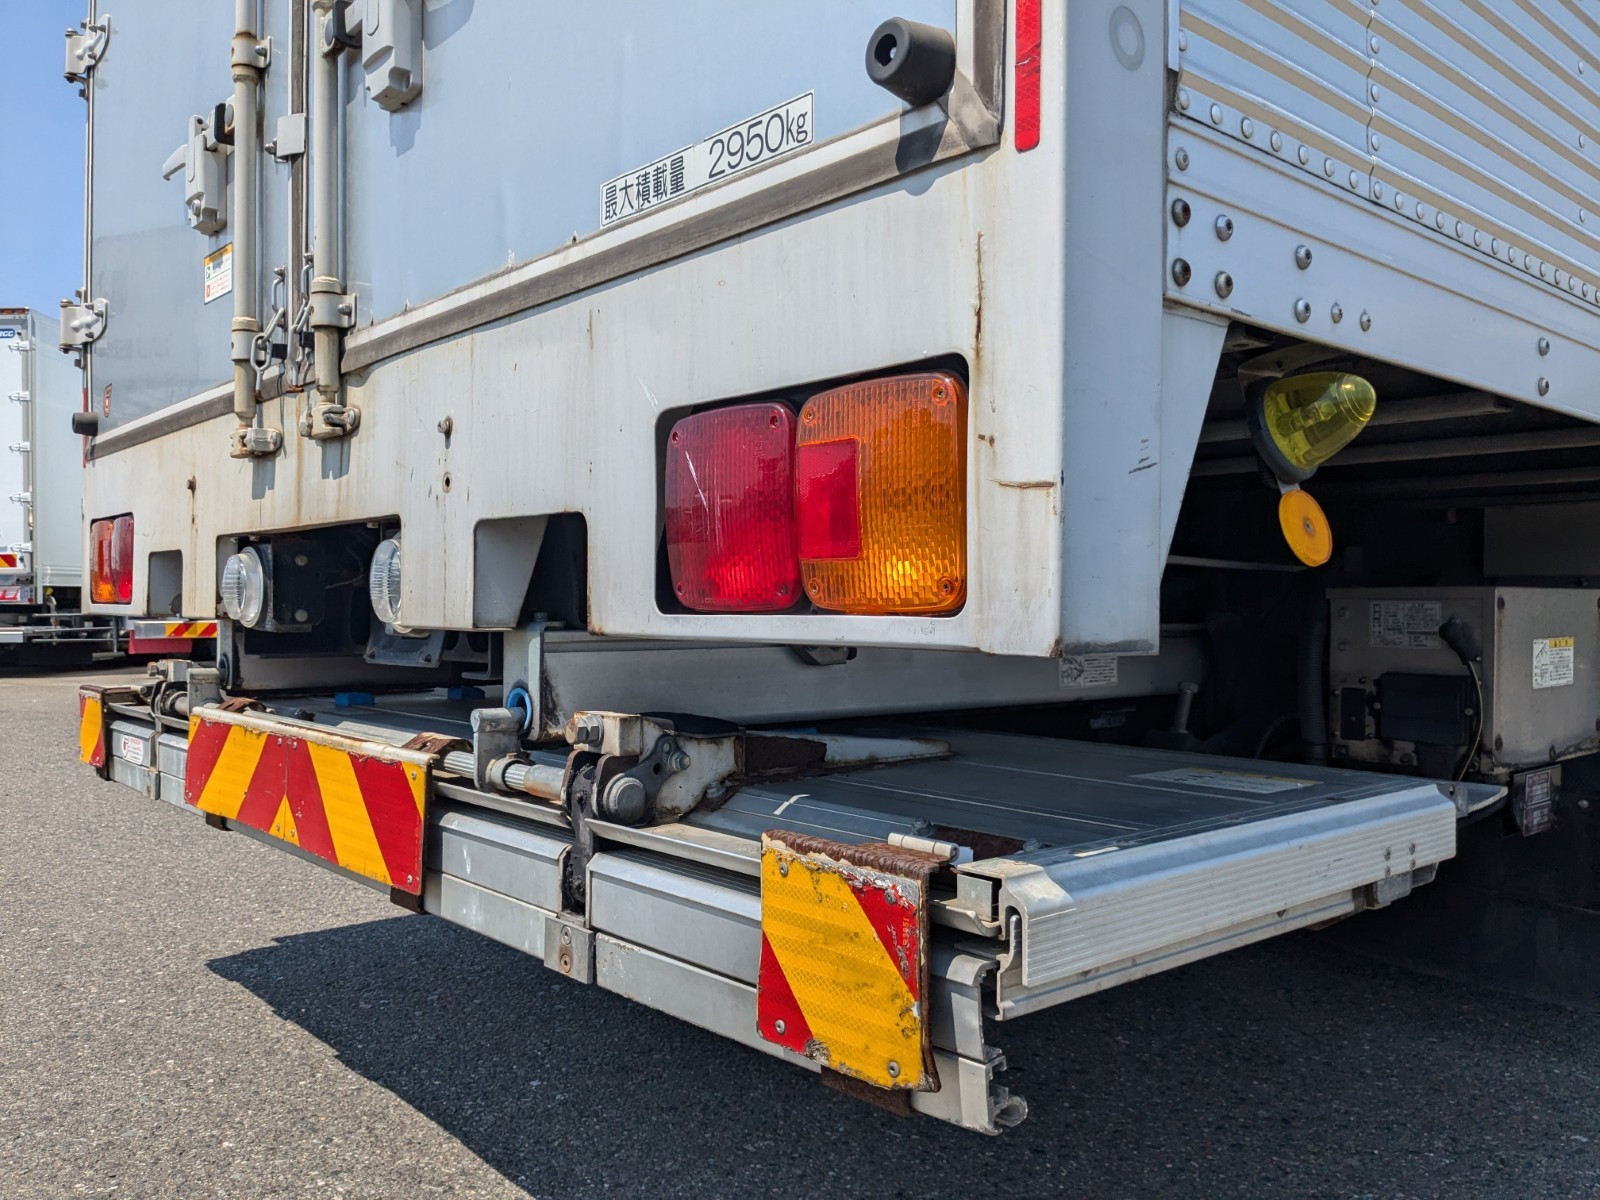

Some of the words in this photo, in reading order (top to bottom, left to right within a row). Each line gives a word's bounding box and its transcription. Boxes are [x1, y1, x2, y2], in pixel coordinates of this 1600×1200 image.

[604, 156, 685, 221] 最大積載量
[708, 109, 808, 179] 2950kg
